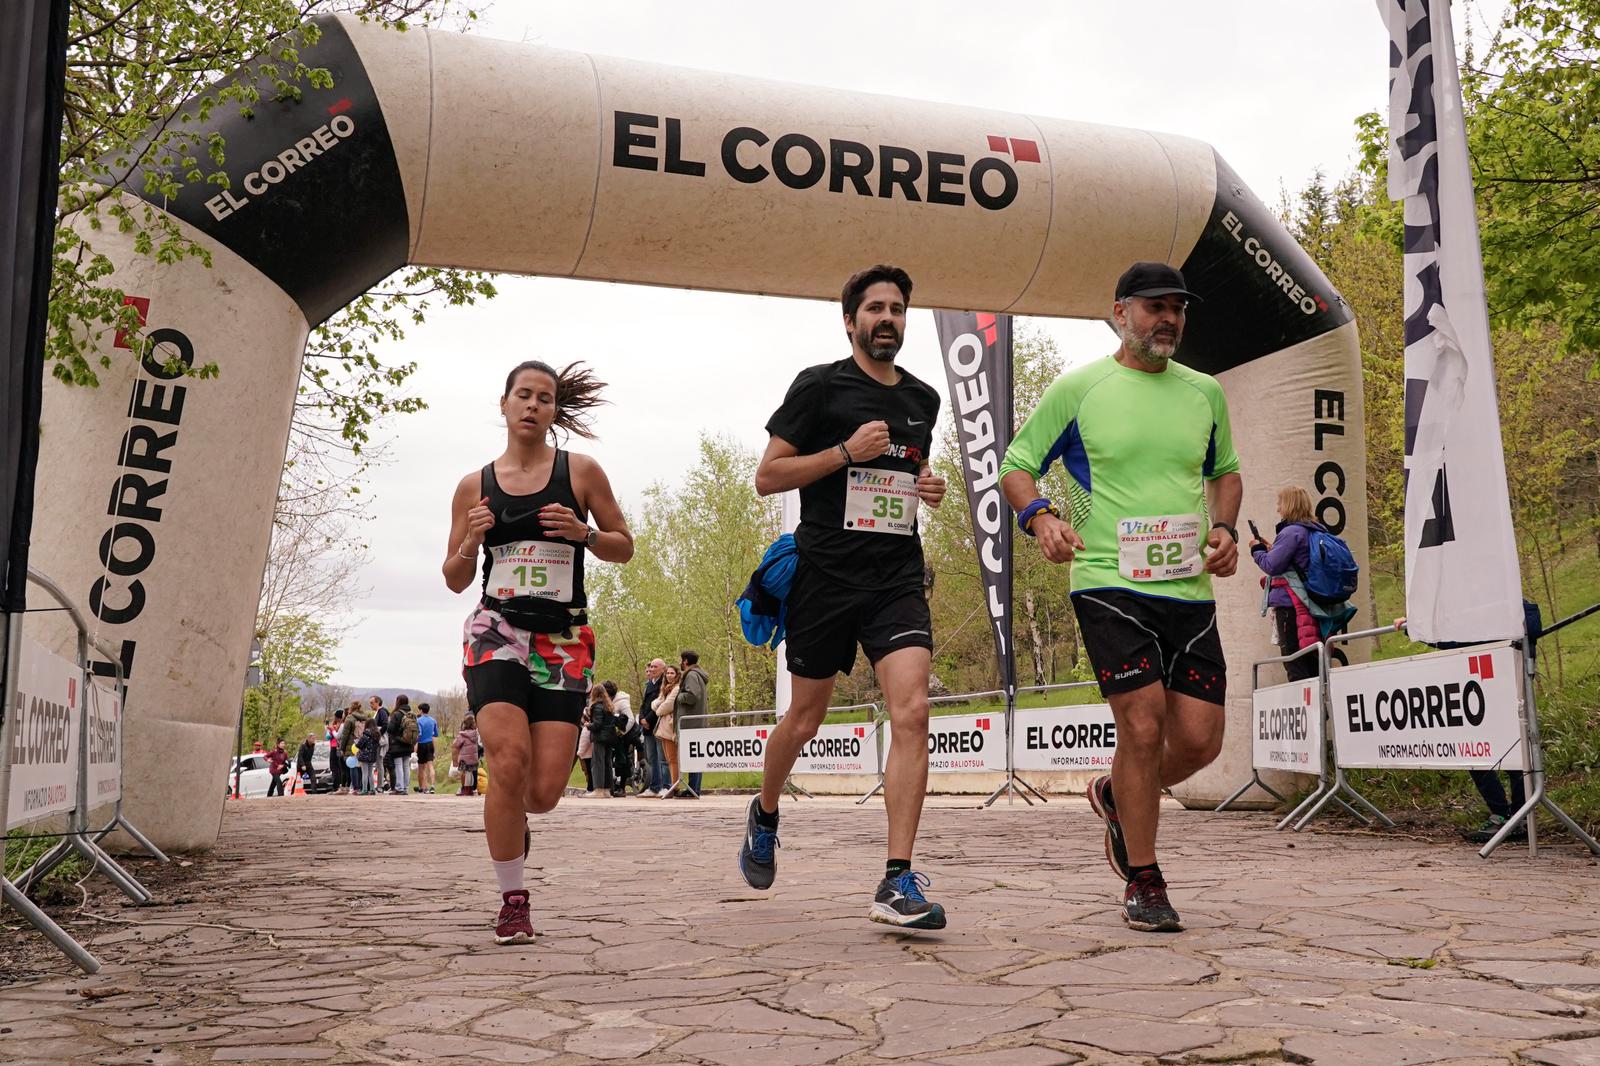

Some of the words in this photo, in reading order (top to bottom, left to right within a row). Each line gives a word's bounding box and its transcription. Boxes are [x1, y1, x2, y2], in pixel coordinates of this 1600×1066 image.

[204, 190, 249, 222] EL
[244, 115, 355, 195] CORREO
[613, 110, 706, 178] EL
[721, 126, 1019, 210] CORREO
[1221, 210, 1243, 242] EL
[1244, 237, 1317, 315] CORREO
[1314, 389, 1345, 451] EL
[89, 328, 194, 624] CORREO
[856, 471, 894, 486] Vital
[869, 487, 900, 496] ESTIBALIZ
[872, 496, 903, 519] 35
[1122, 520, 1168, 534] Vital
[495, 545, 536, 557] Vital
[1147, 542, 1182, 566] 62
[512, 566, 548, 587] 15
[1114, 669, 1142, 680] SURAL
[1346, 694, 1373, 732] EL
[1375, 680, 1485, 731] CORREO
[12, 691, 26, 764] EL
[28, 696, 70, 765] CORREO
[1259, 710, 1269, 740] EL
[1270, 706, 1308, 740] CORREO
[928, 731, 984, 754] ORREO
[1027, 727, 1049, 749] EL
[1052, 723, 1116, 749] CORRE
[689, 741, 705, 758] EL
[706, 739, 763, 758] CORREO
[810, 738, 860, 757] CORREO
[1378, 740, 1435, 758] INFORMACIÓN
[1436, 743, 1456, 758] CON
[1458, 742, 1491, 758] VALOR
[706, 761, 737, 769] INFORMACIÓN
[950, 760, 984, 768] BALIOTSUA
[1051, 757, 1090, 766] INFORMAZIO
[1091, 756, 1113, 765] BALIO
